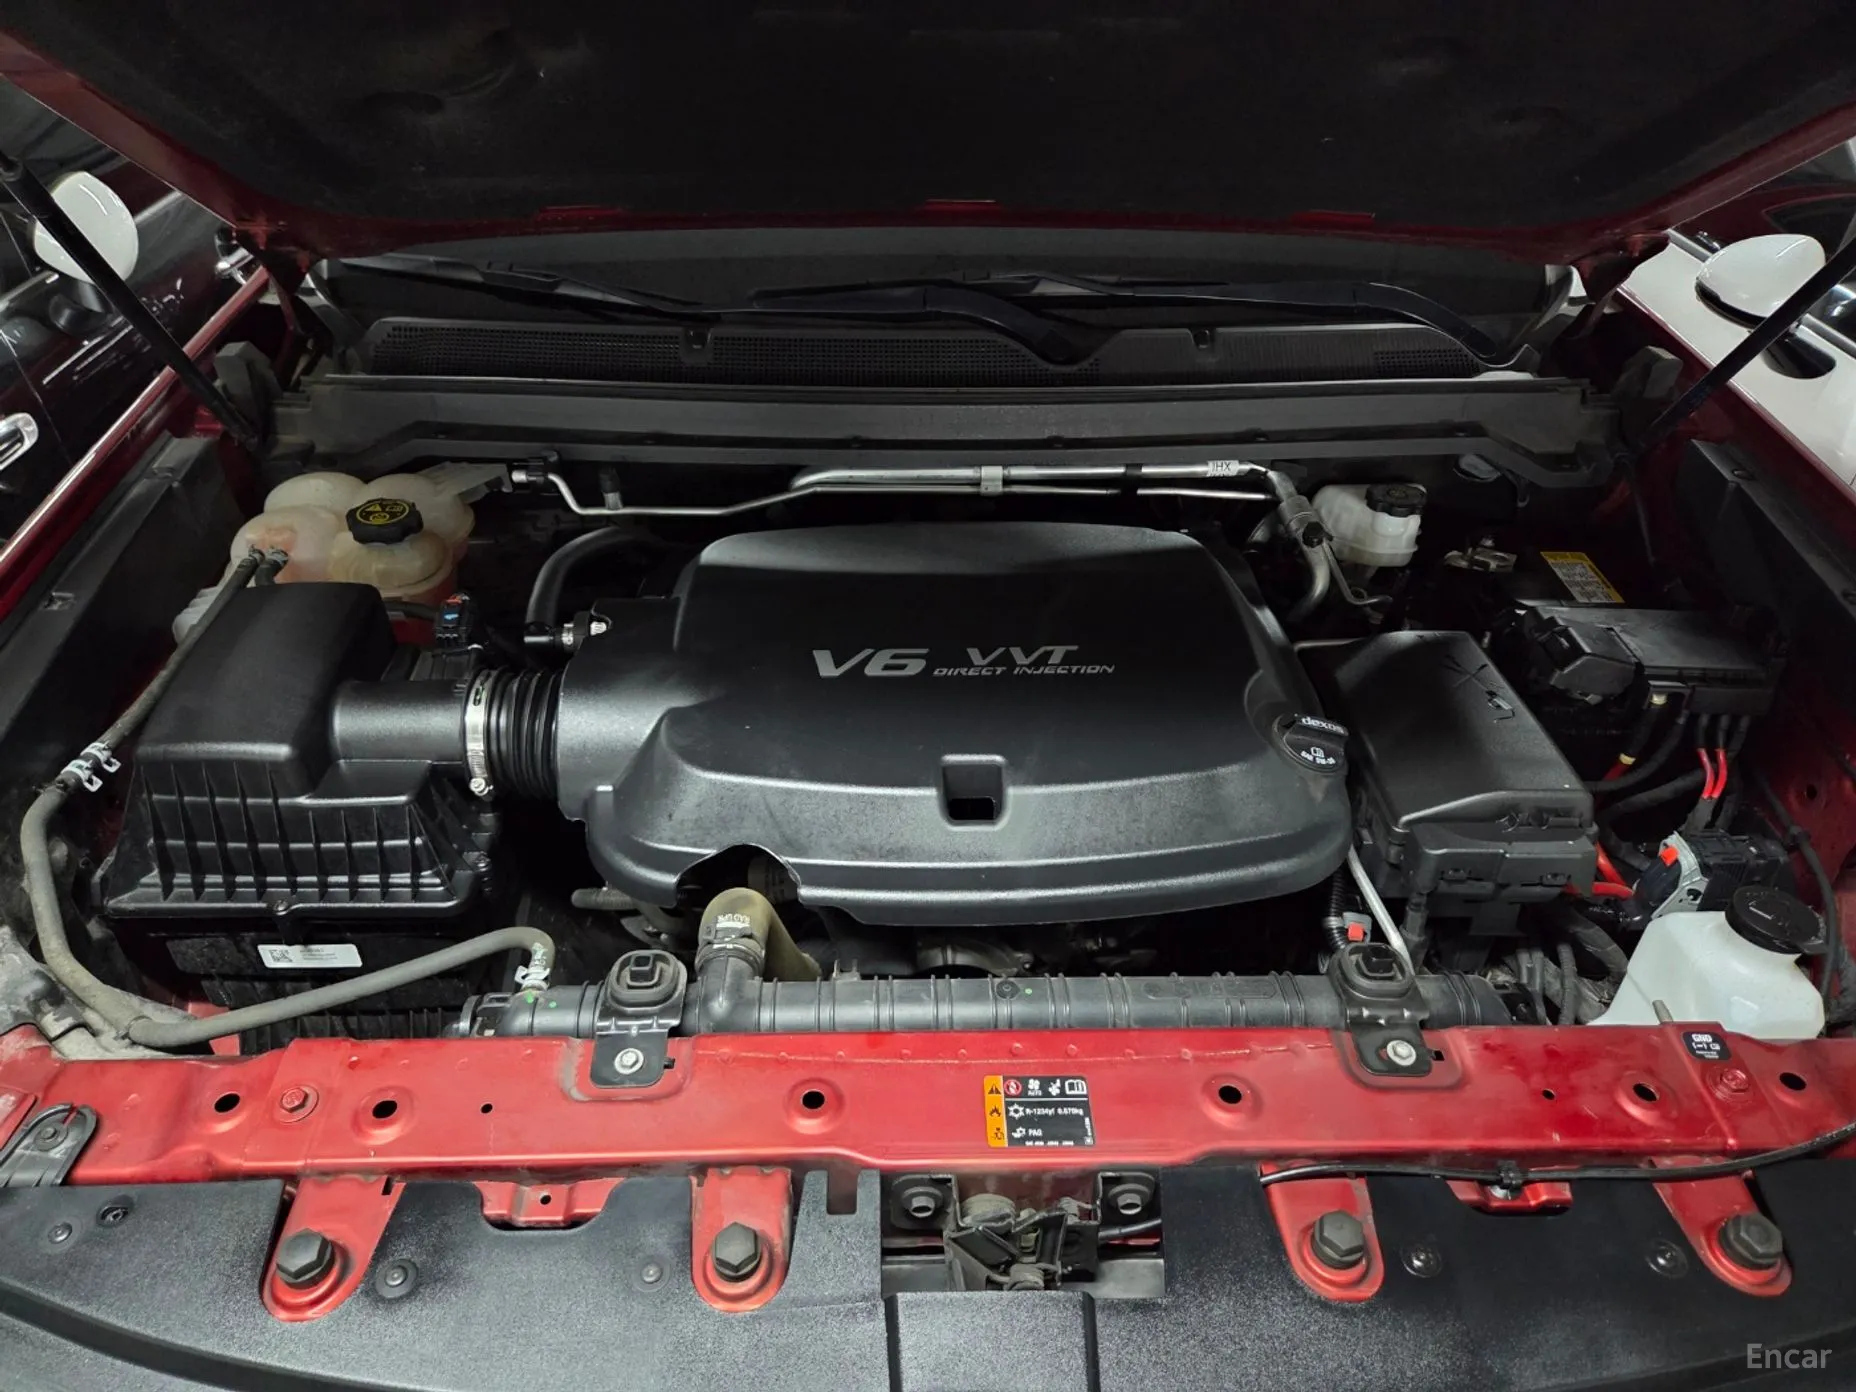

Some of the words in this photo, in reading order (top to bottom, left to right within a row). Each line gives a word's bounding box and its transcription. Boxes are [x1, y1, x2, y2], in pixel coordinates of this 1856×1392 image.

[812, 648, 929, 678] V6
[966, 645, 1079, 666] VVT
[932, 666, 1007, 677] DIRECT
[1012, 664, 1116, 675] INJECTION
[1301, 716, 1345, 734] dexos
